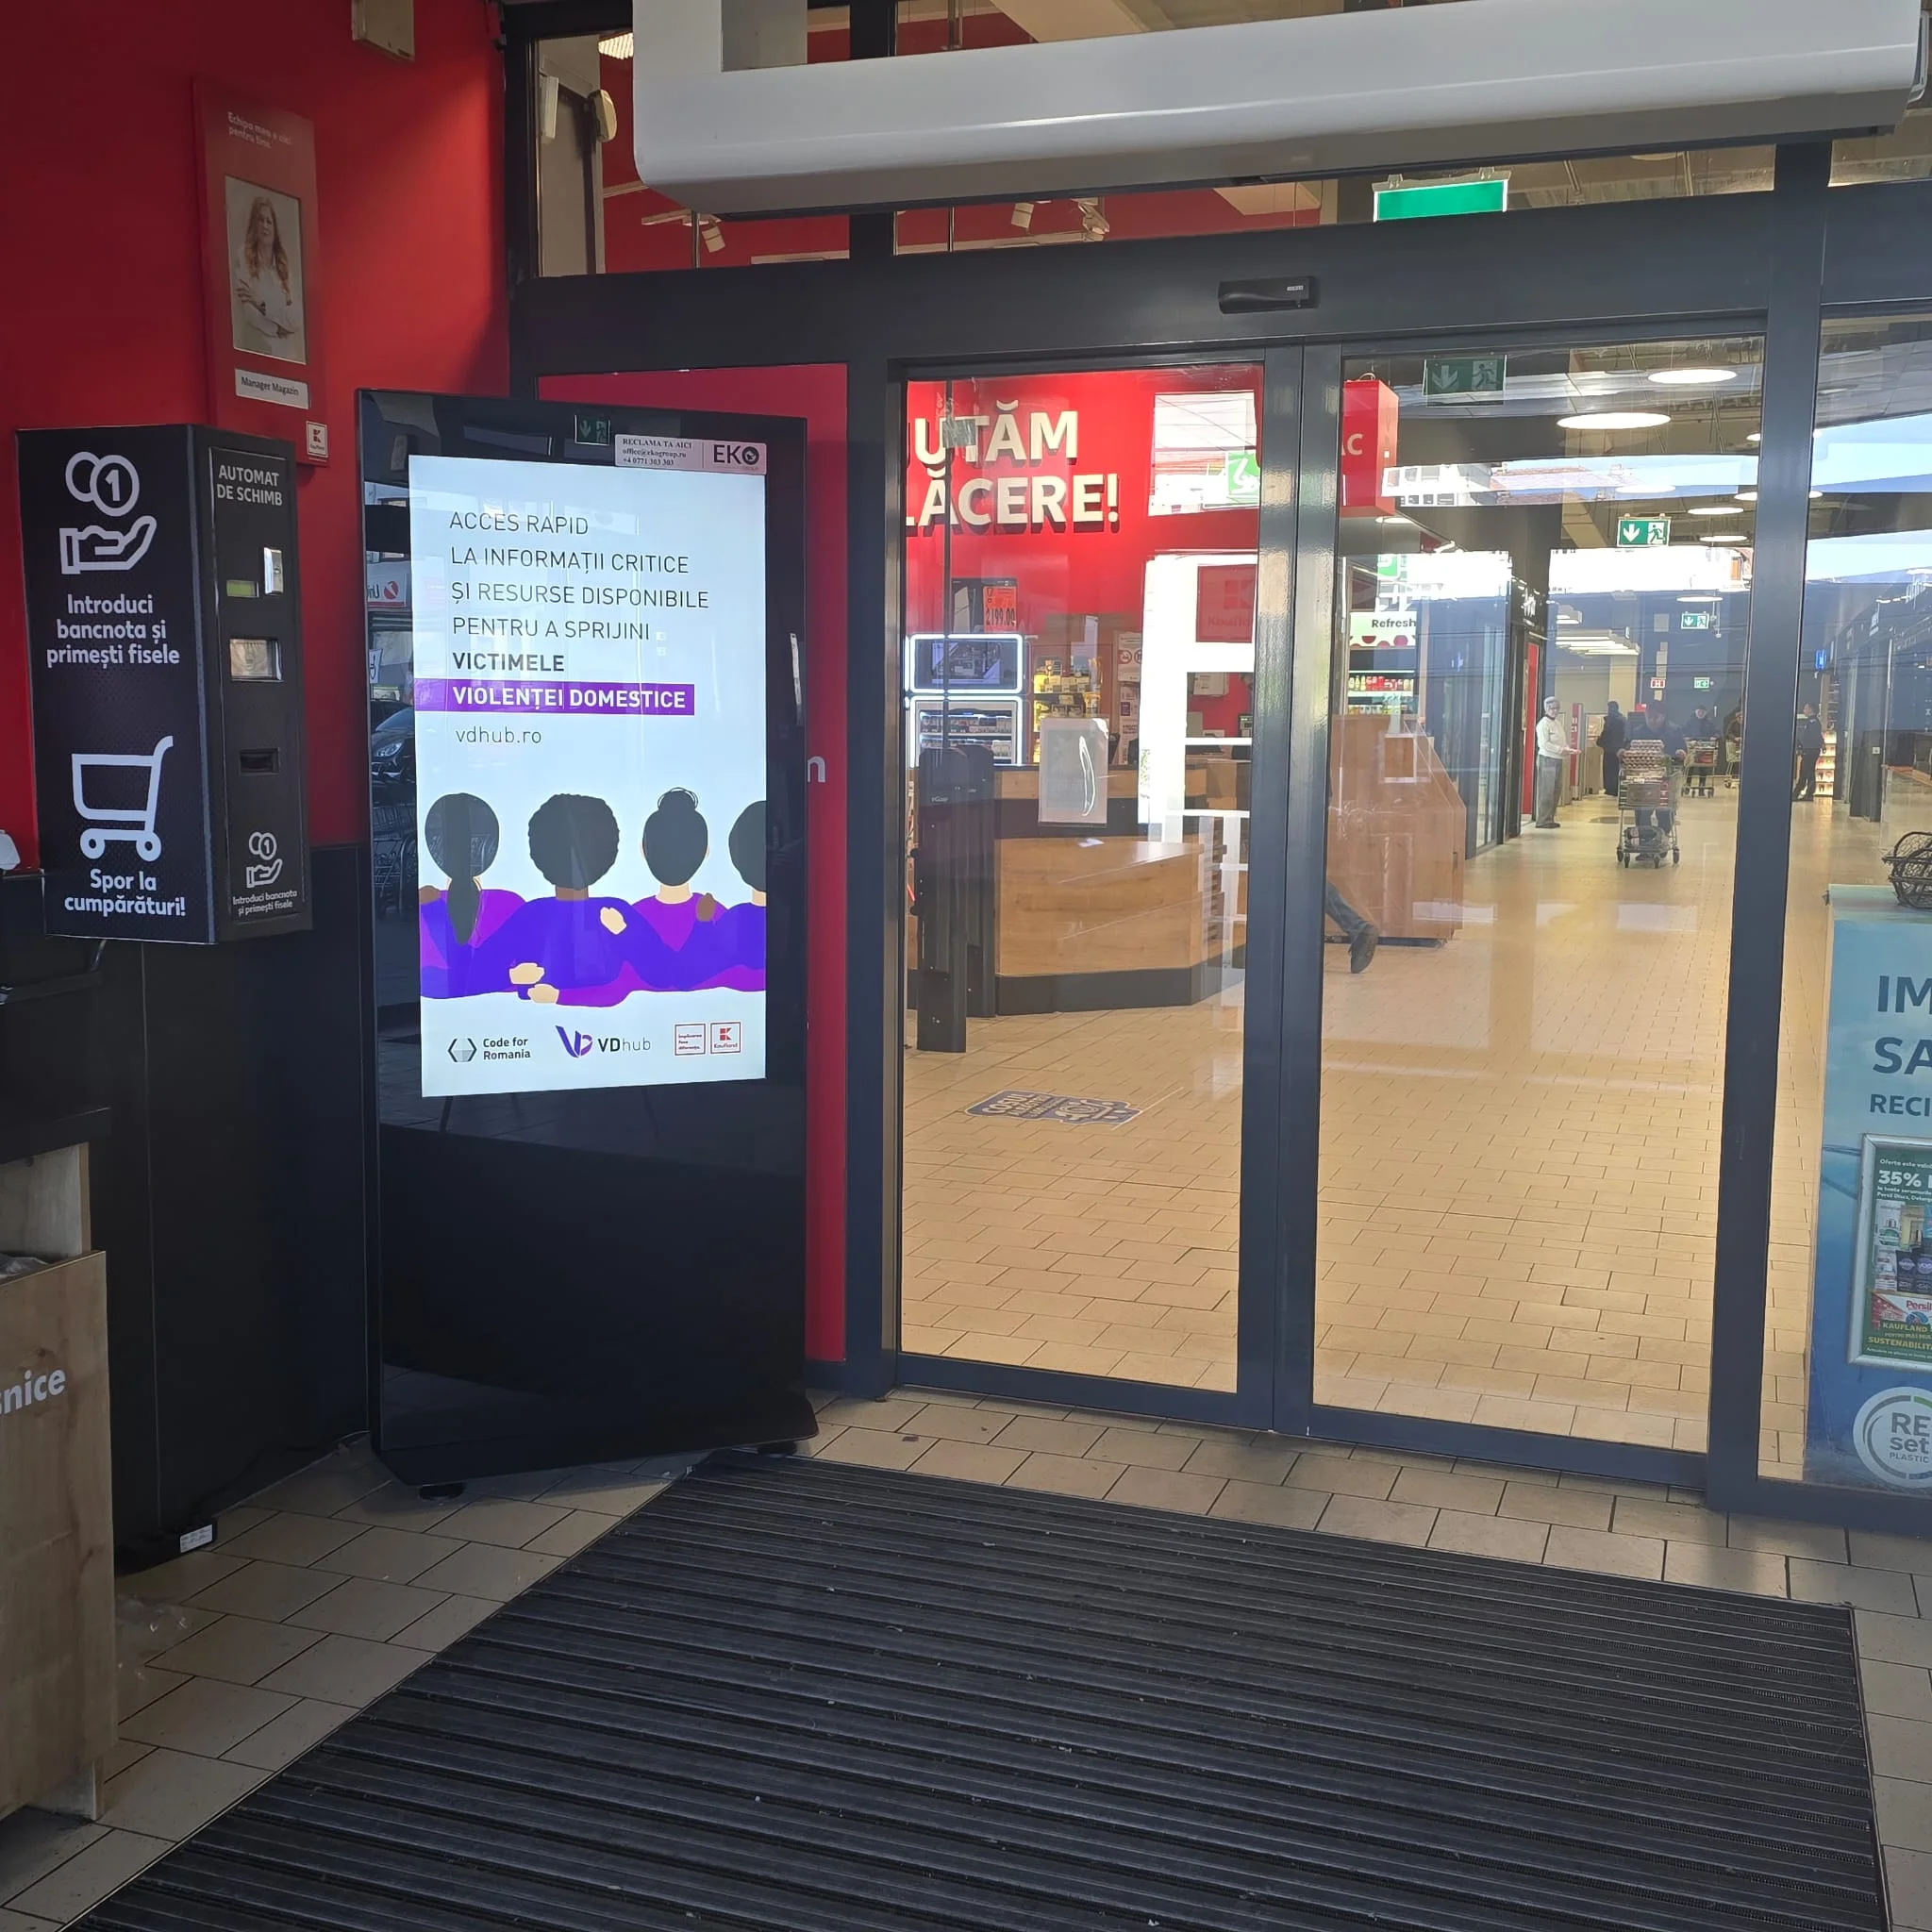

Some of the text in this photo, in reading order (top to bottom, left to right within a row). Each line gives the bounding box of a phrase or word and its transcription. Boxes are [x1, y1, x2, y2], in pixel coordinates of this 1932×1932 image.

[241, 376, 299, 396] Manager Magazin
[623, 438, 662, 447] RECLAMA
[218, 465, 280, 487] AUTOMAT
[216, 484, 283, 507] DE SCHIMB
[906, 467, 1120, 528] ĂCERE!
[449, 511, 589, 535] ACCES RAPID
[451, 546, 690, 574] LA INFORMAȚII CRITICE
[66, 593, 154, 614] Introduci
[451, 581, 709, 609] ȘI RESURSE DISPONIBILE
[56, 619, 167, 644] bancnota și
[453, 616, 650, 641] PENTRU A SPRIJINI
[1372, 618, 1416, 628] Refresh
[46, 642, 181, 669] primești fisele
[452, 652, 565, 673] VICTIMELE
[452, 686, 687, 709] VIOLENȚEI DOMESTICE
[456, 725, 542, 744] vdhub.ro
[89, 869, 158, 893] Spor la
[64, 894, 187, 917] cumpărături!
[232, 892, 265, 906] Introduci
[483, 1036, 528, 1049] Code for
[597, 1037, 652, 1053] VDhub
[483, 1048, 531, 1060] Romania
[1878, 1170, 1922, 1188] 35%
[1906, 1300, 1932, 1311] Persil
[1882, 1323, 1928, 1332] KAUFLAND
[0, 1369, 67, 1415] nice
[1890, 1412, 1931, 1438] RE
[1890, 1437, 1930, 1455] set
[1889, 1452, 1930, 1464] PLASTIC
